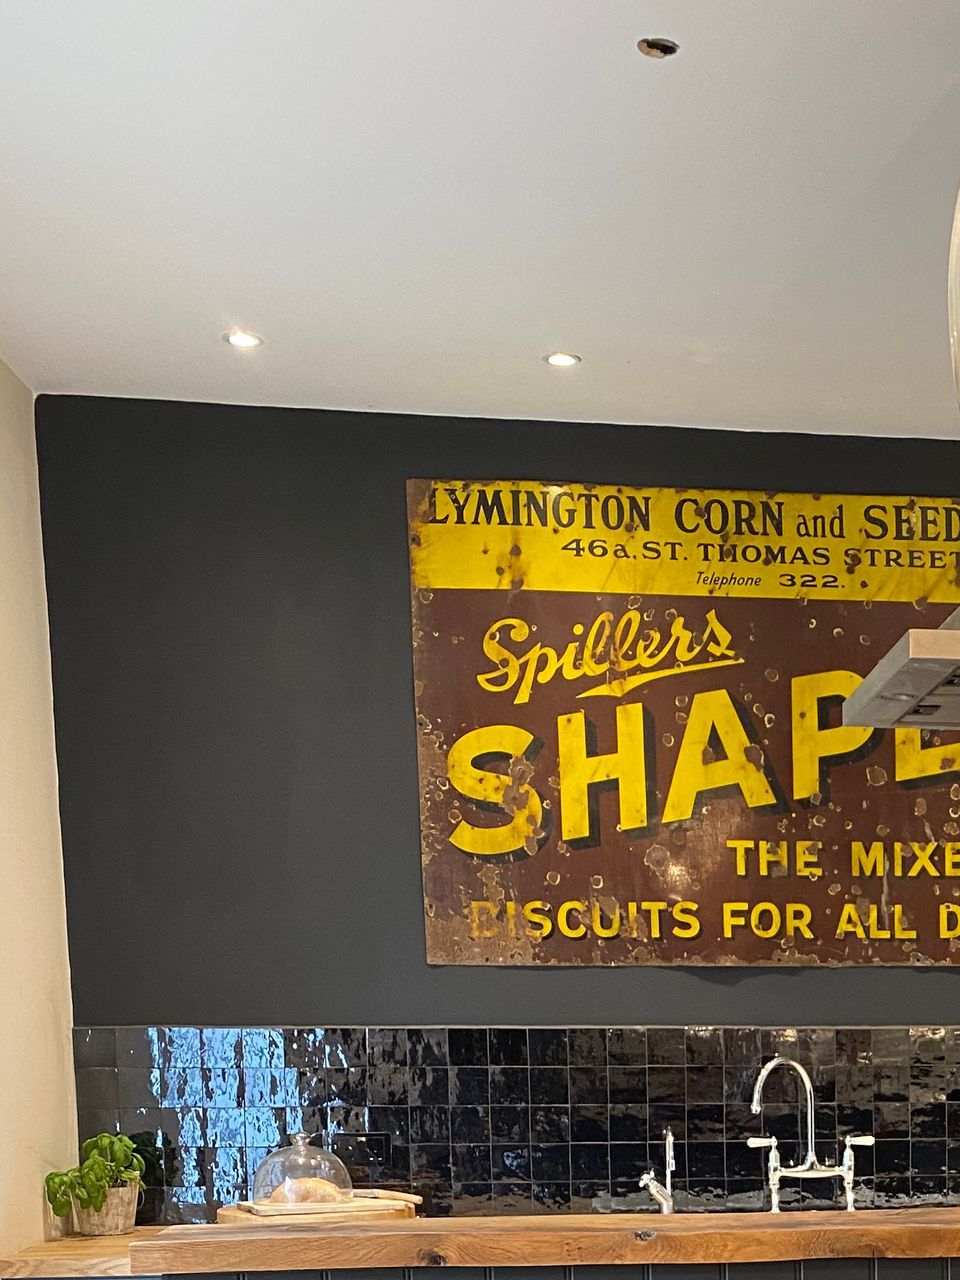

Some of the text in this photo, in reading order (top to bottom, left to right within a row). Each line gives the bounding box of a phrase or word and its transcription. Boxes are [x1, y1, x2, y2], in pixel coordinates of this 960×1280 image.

[427, 487, 651, 532] LYMINGTON
[673, 498, 785, 537] CORN
[796, 504, 846, 538] and
[697, 543, 830, 566] THOMAS
[696, 571, 845, 590] Telephone 322.
[476, 608, 744, 704] Spillers
[726, 840, 823, 876] THE
[723, 901, 814, 939] FOR
[836, 903, 917, 939] ALL
